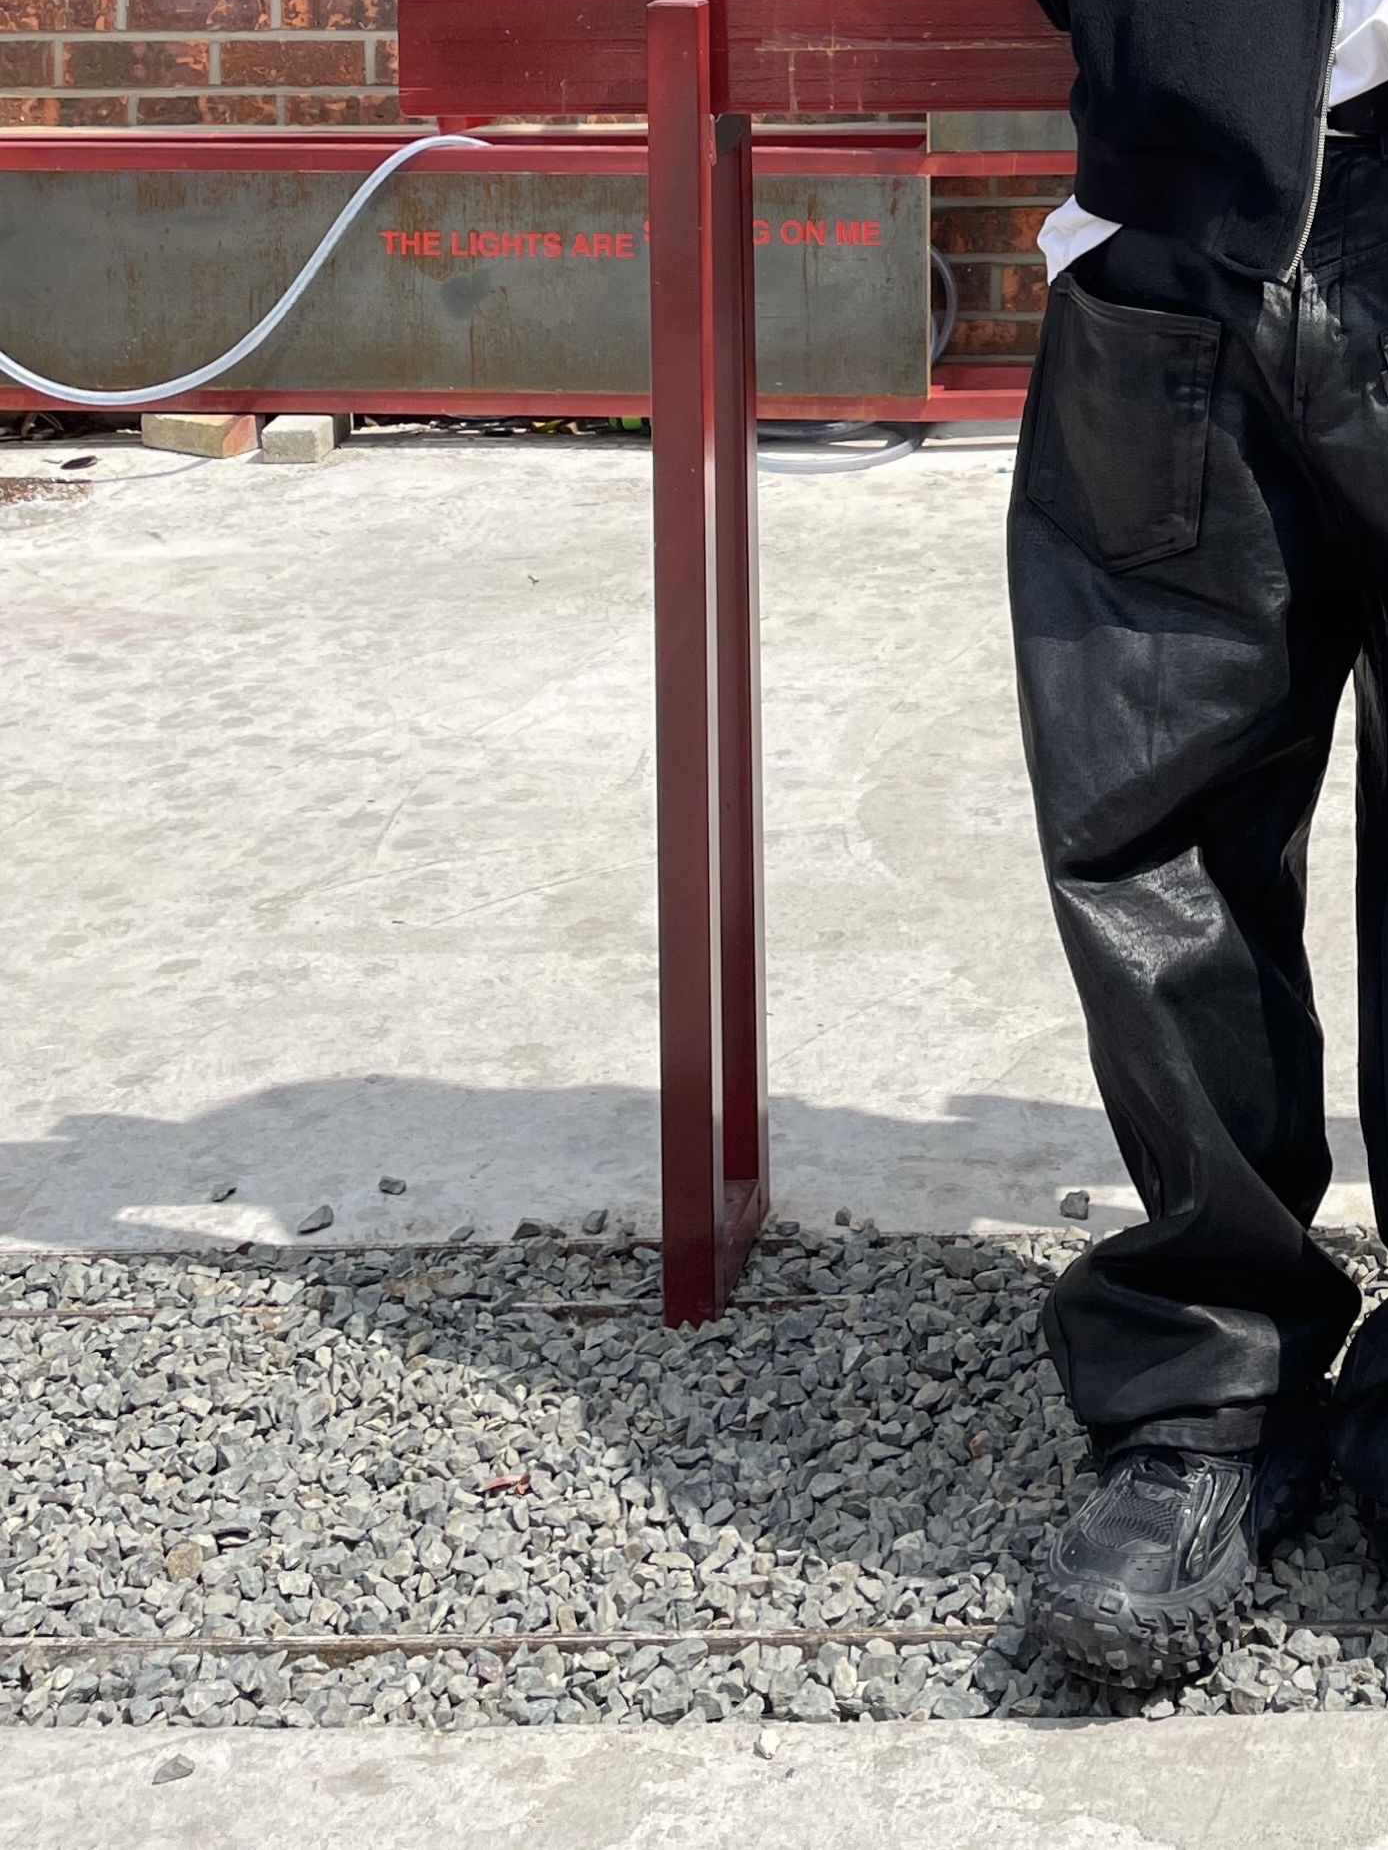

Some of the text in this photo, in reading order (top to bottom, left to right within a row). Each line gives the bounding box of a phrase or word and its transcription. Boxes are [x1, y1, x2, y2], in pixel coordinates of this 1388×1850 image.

[380, 230, 442, 256] THE
[451, 230, 563, 257] LIGHTS
[571, 233, 635, 258] ARE
[780, 219, 826, 246] ON
[835, 220, 882, 246] ME
